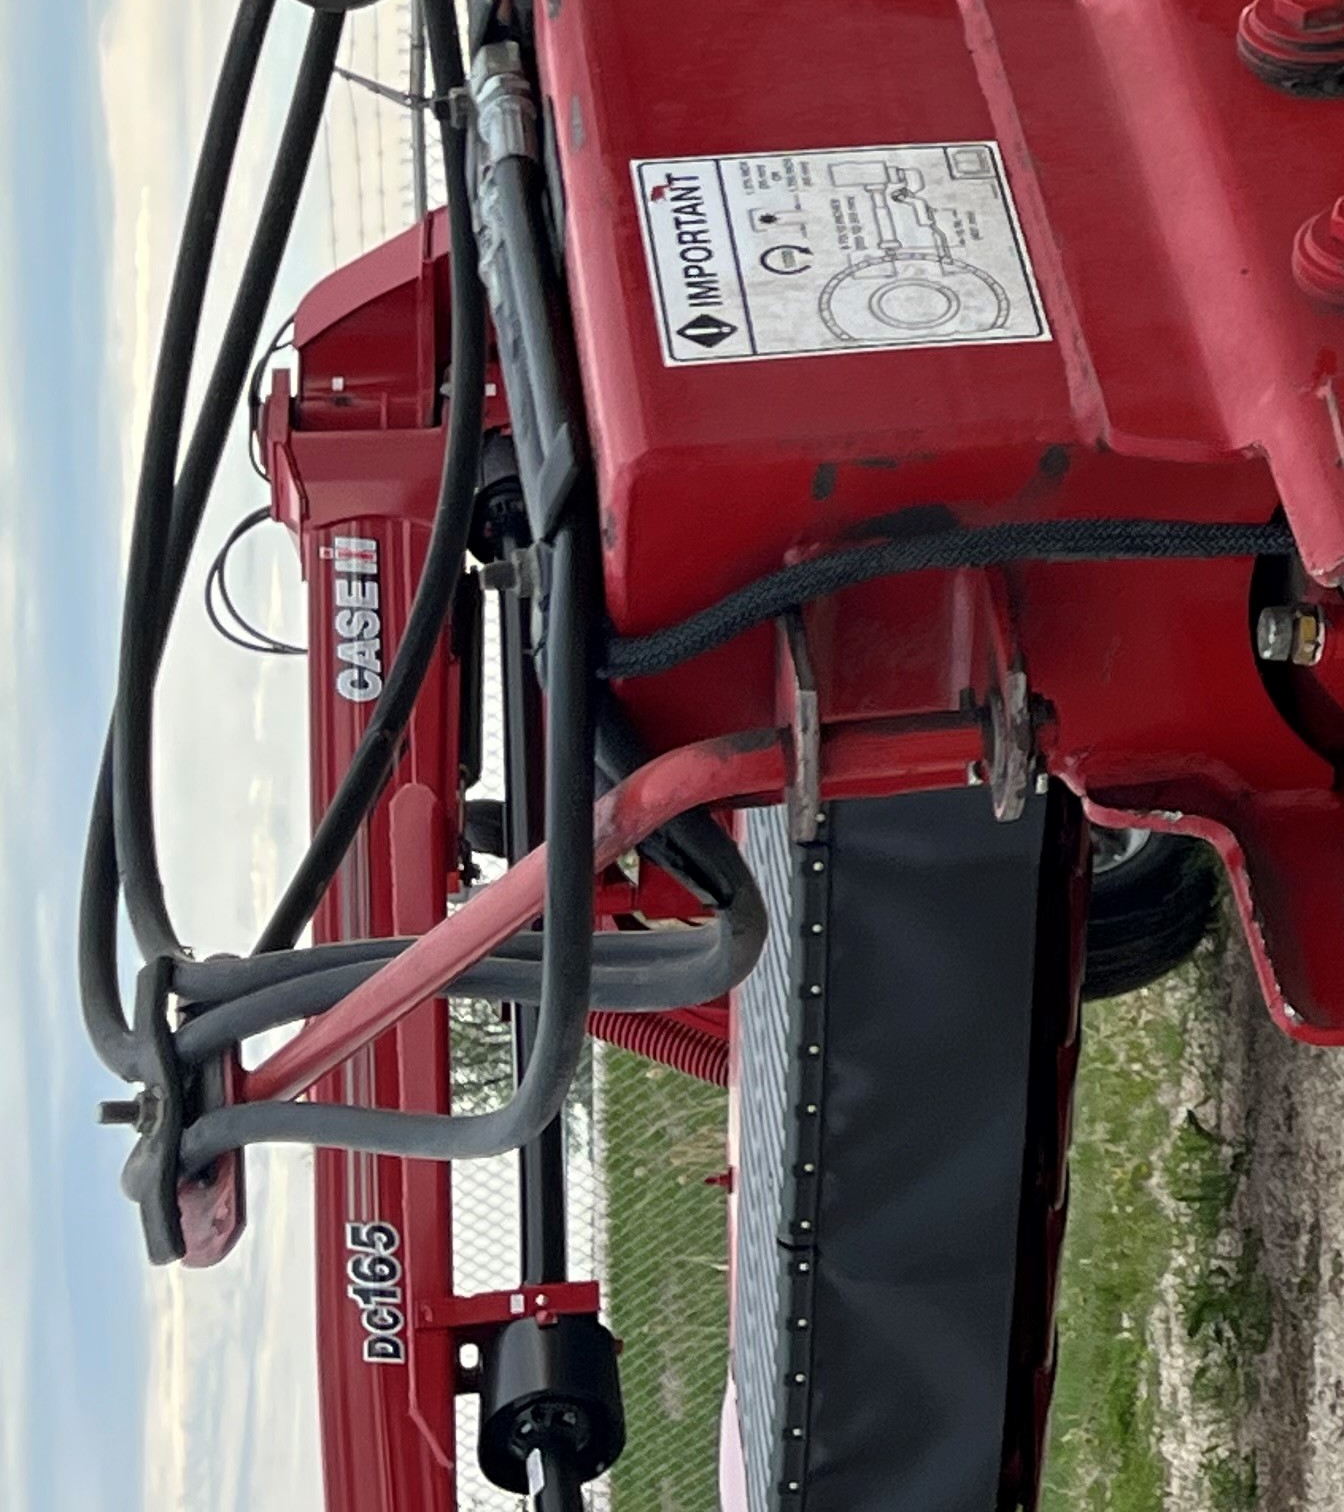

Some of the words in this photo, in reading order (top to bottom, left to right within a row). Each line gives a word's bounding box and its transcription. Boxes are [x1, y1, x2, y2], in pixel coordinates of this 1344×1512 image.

[666, 172, 724, 308] IMPORTANT
[335, 579, 383, 703] CASE
[345, 1221, 405, 1364] DC165
